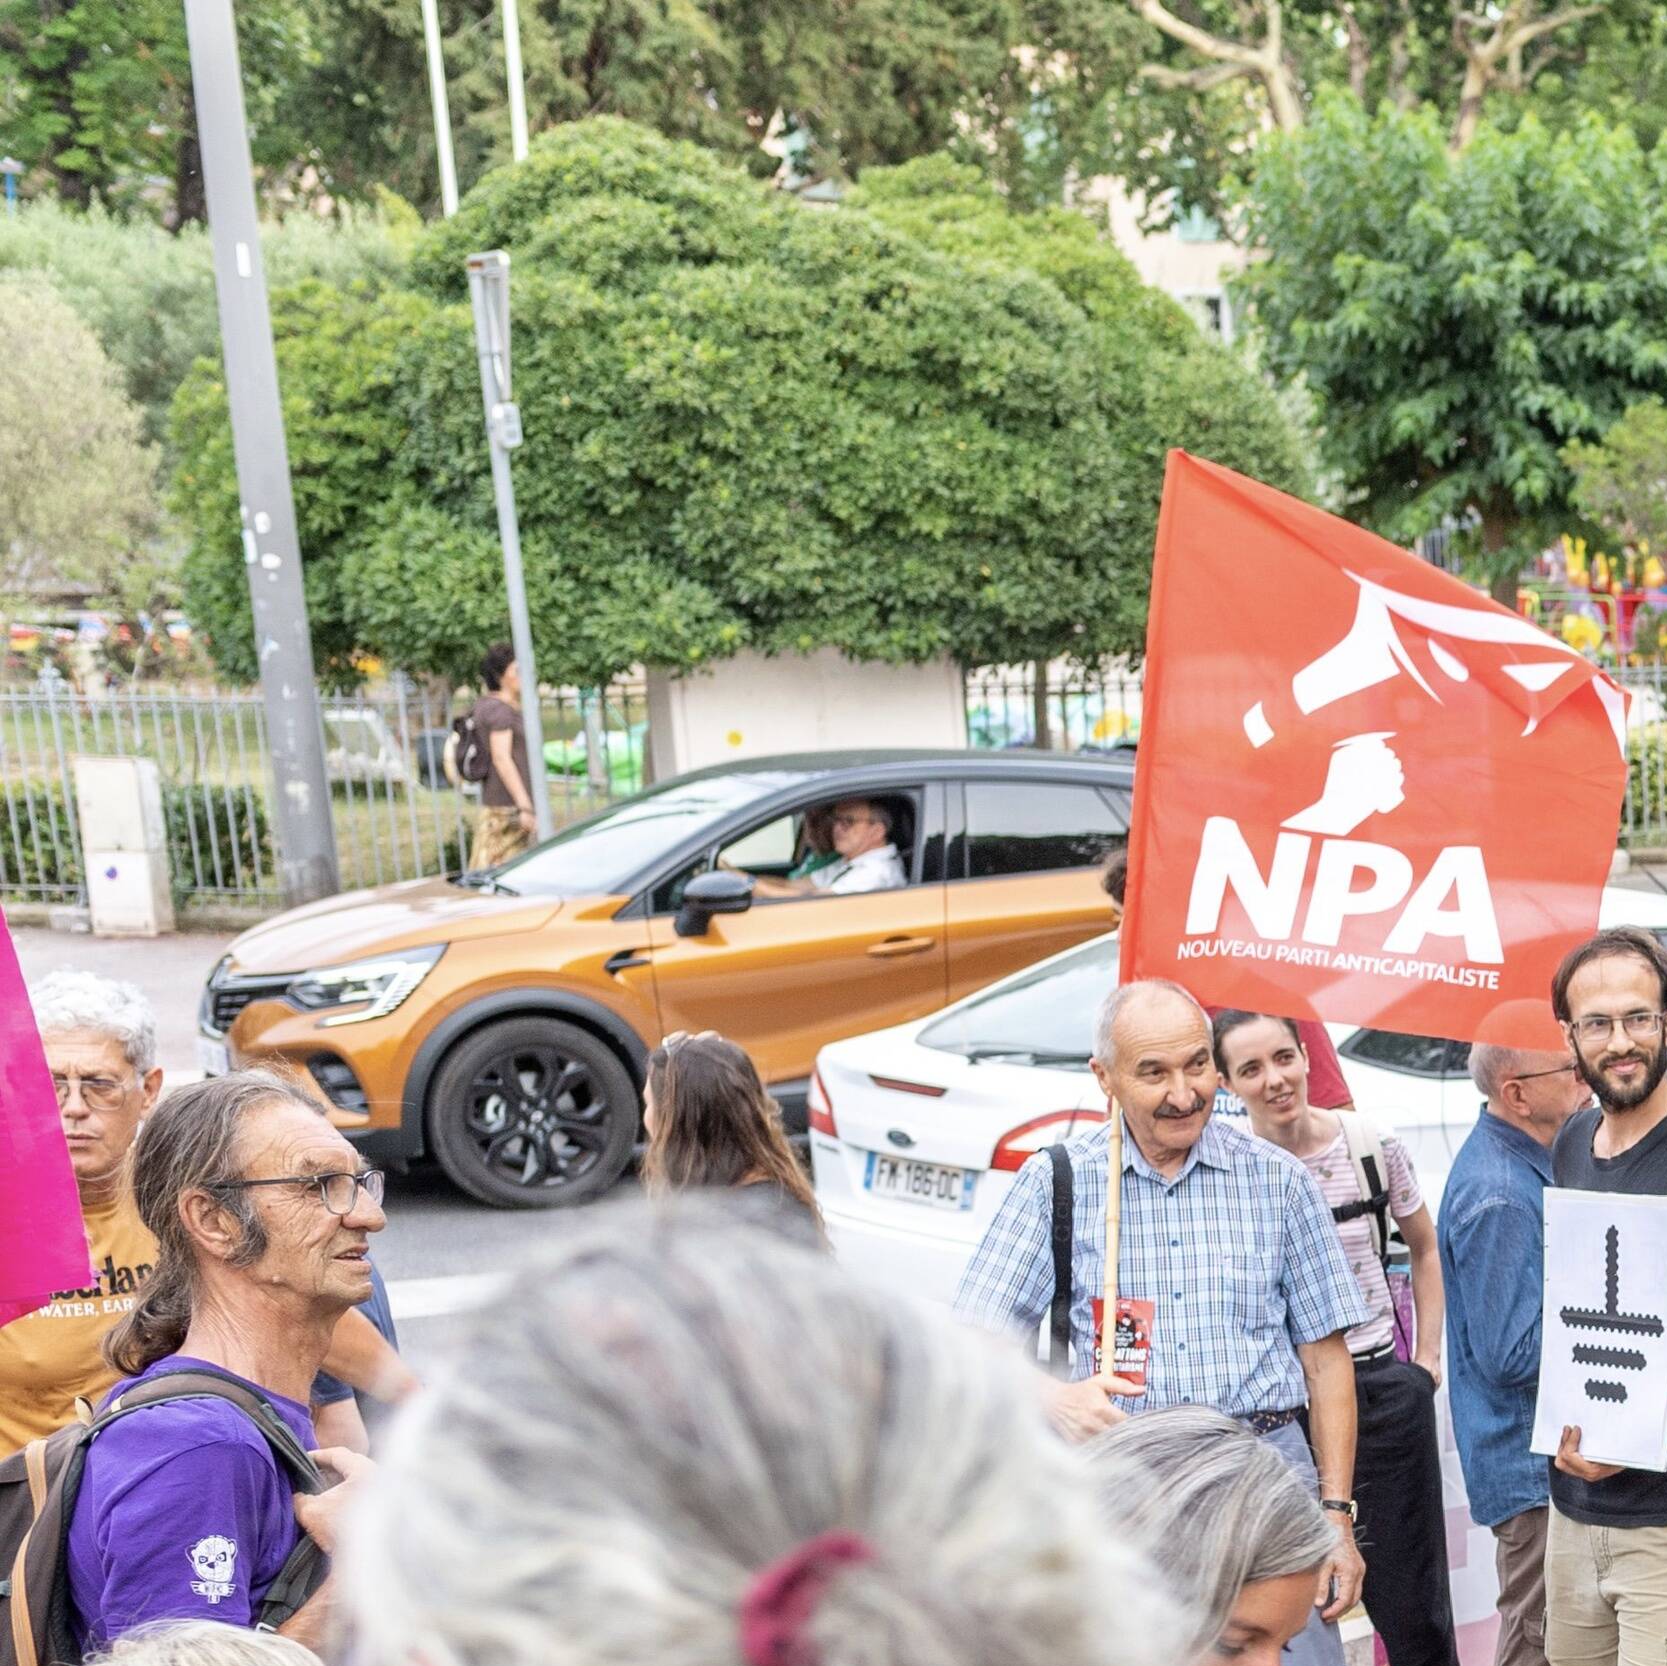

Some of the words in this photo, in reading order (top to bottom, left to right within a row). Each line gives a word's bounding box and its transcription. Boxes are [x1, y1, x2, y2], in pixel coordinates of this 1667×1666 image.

[1185, 816, 1504, 964] NPA
[1177, 939, 1272, 960] NOUVEAU
[1275, 944, 1330, 968] PARTI
[1331, 948, 1500, 991] ANTICAPITALISTE
